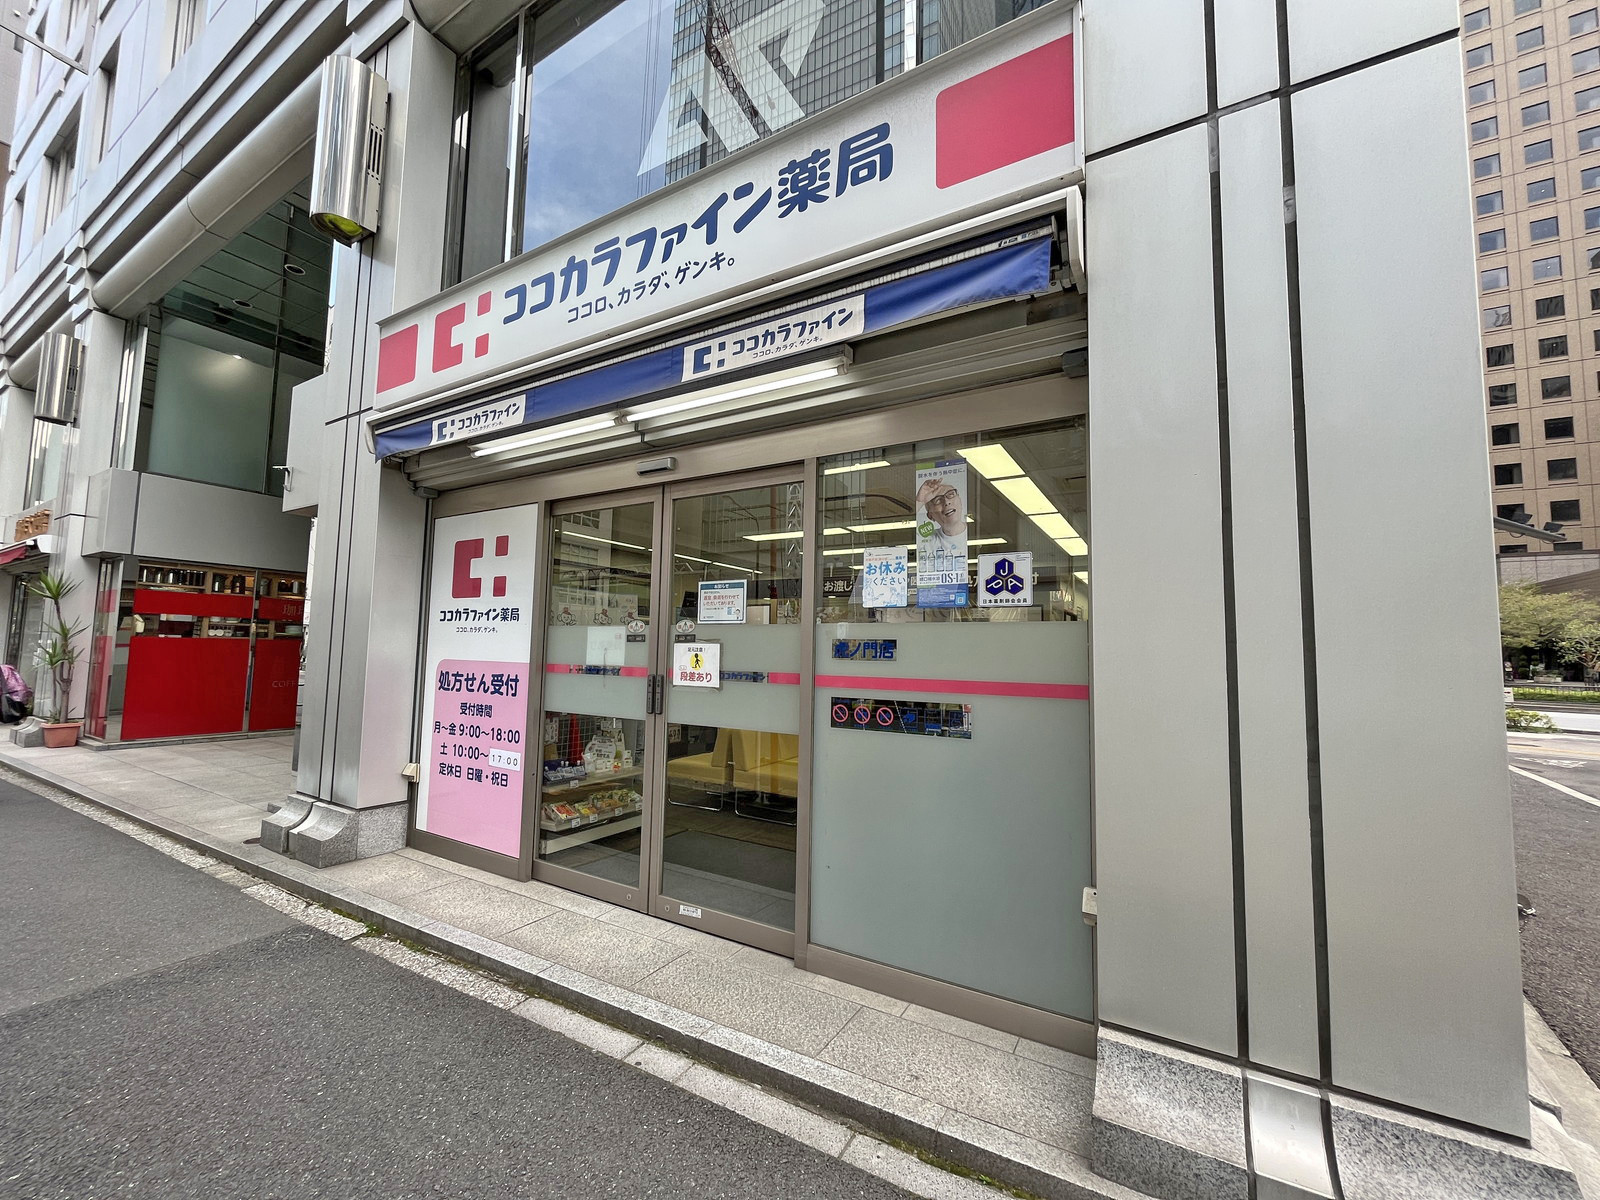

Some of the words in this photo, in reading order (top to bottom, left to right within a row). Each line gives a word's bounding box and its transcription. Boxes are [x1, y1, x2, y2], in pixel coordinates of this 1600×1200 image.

[502, 121, 894, 325] ココカラファイン薬局
[567, 251, 735, 323] ココロ、カラダ、ゲンキ。
[732, 307, 853, 356] ココカラファイン
[458, 402, 520, 430] ココカラファイン
[920, 523, 933, 533] NEW
[865, 561, 906, 576] お休み
[873, 576, 906, 586] ください
[941, 573, 959, 584] OS-1
[439, 607, 520, 622] ココカラファイン薬局
[438, 670, 520, 697] 処方せん受付
[679, 671, 713, 682] 段差あり
[459, 702, 493, 718] 受付時間
[440, 742, 448, 755] 土
[438, 762, 462, 778] 定休日
[467, 767, 509, 787] 日曜・祝日
